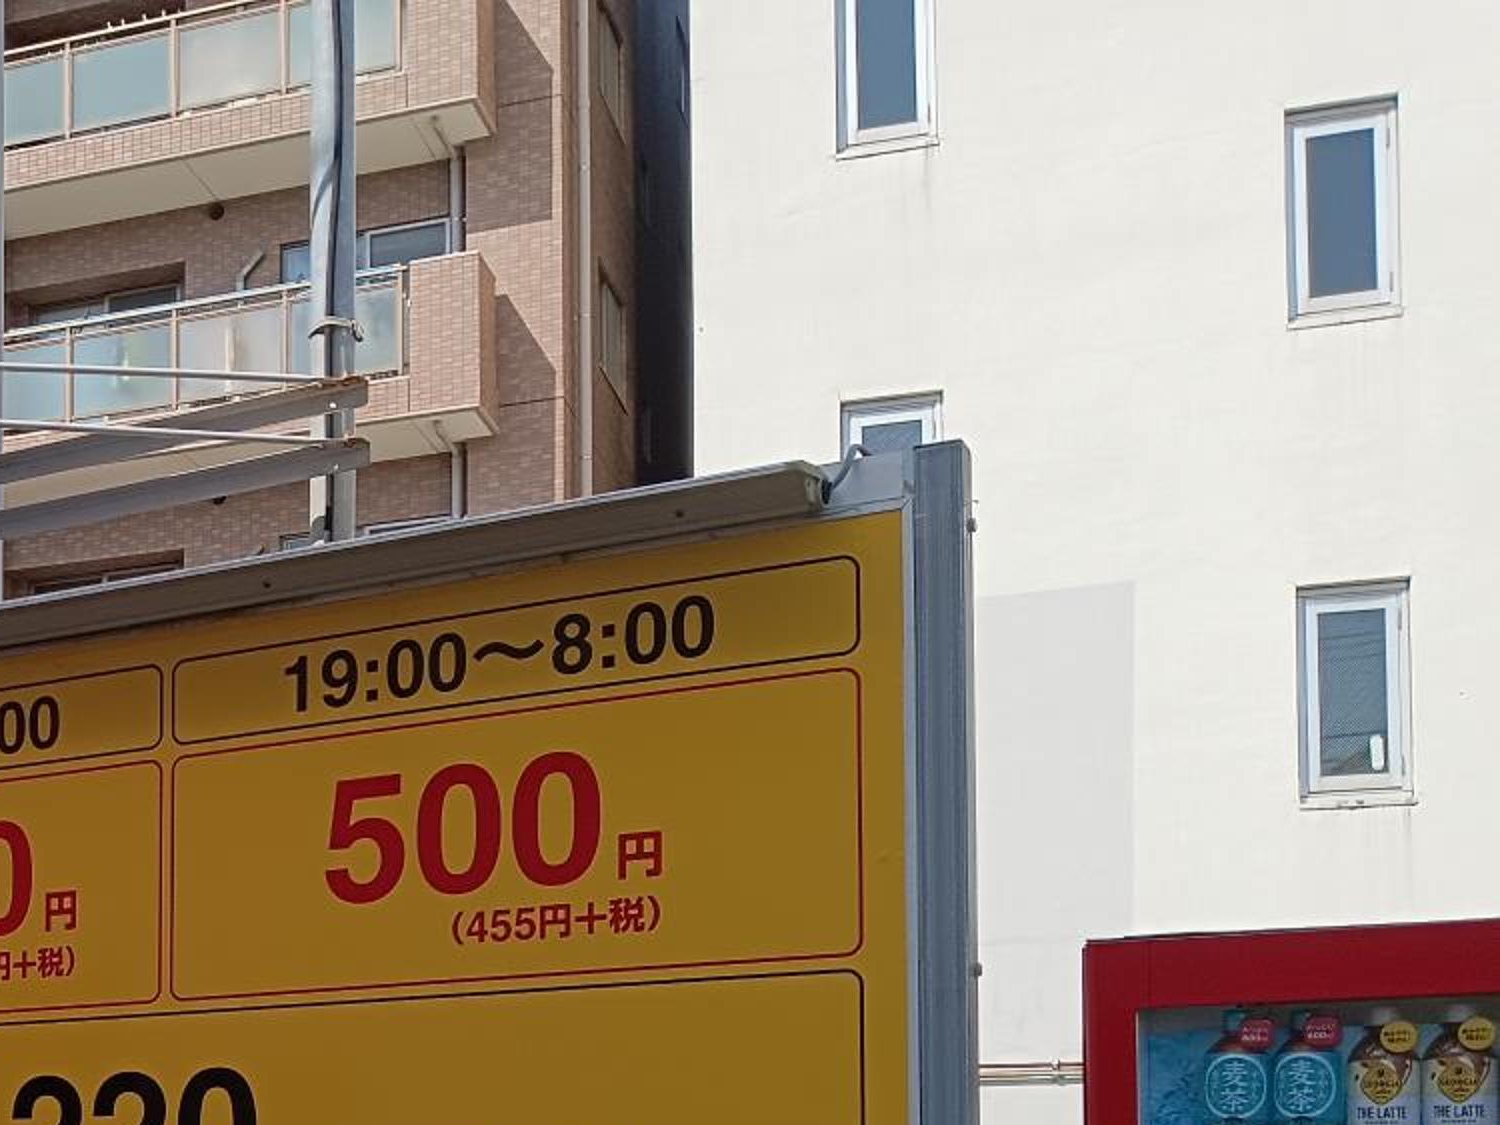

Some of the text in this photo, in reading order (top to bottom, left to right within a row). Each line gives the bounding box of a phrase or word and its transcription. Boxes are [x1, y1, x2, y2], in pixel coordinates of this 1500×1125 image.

[1219, 1059, 1250, 1113] 麦茶
[1287, 1058, 1317, 1112] 麦茶
[1453, 1104, 1486, 1119] LATTE
